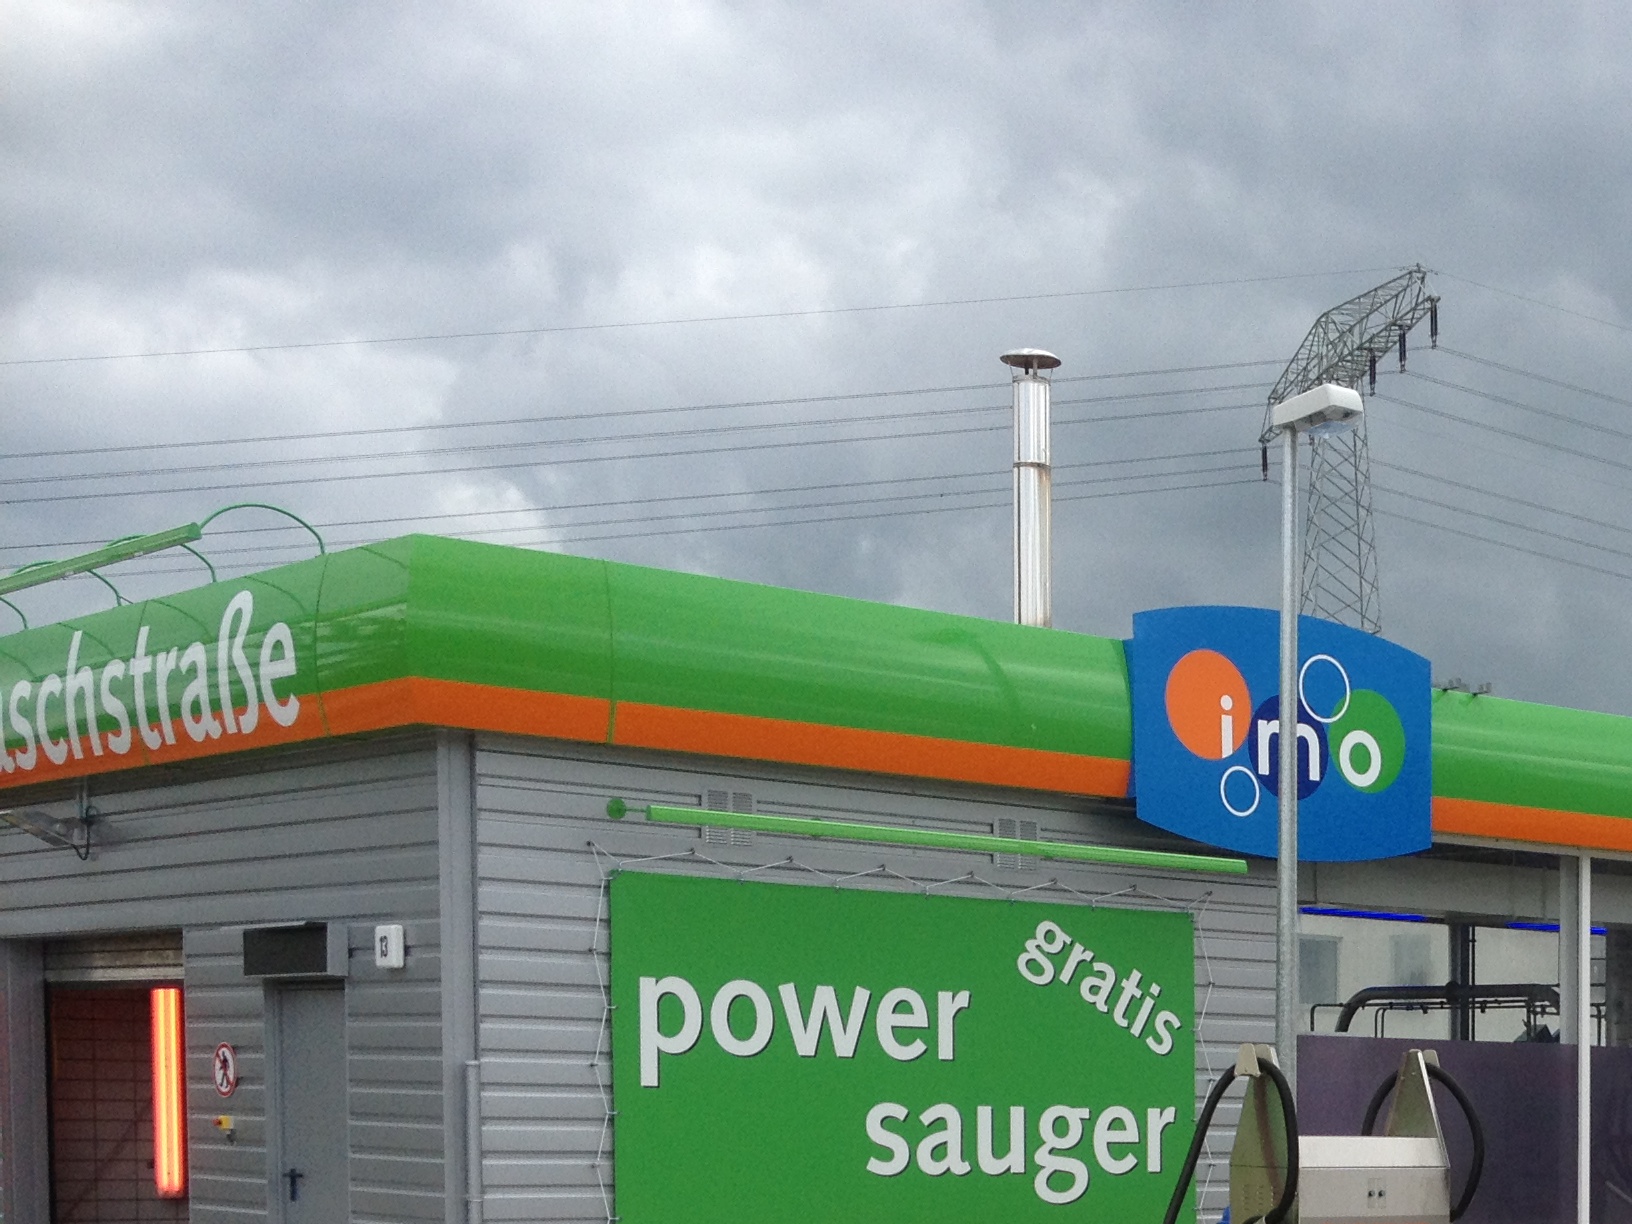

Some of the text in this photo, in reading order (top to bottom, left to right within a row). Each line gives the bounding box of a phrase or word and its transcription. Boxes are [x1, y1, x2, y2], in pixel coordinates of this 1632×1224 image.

[1220, 695, 1382, 787] imo
[638, 975, 971, 1088] power
[1016, 919, 1183, 1056] gratis
[865, 1101, 1177, 1205] sauger
